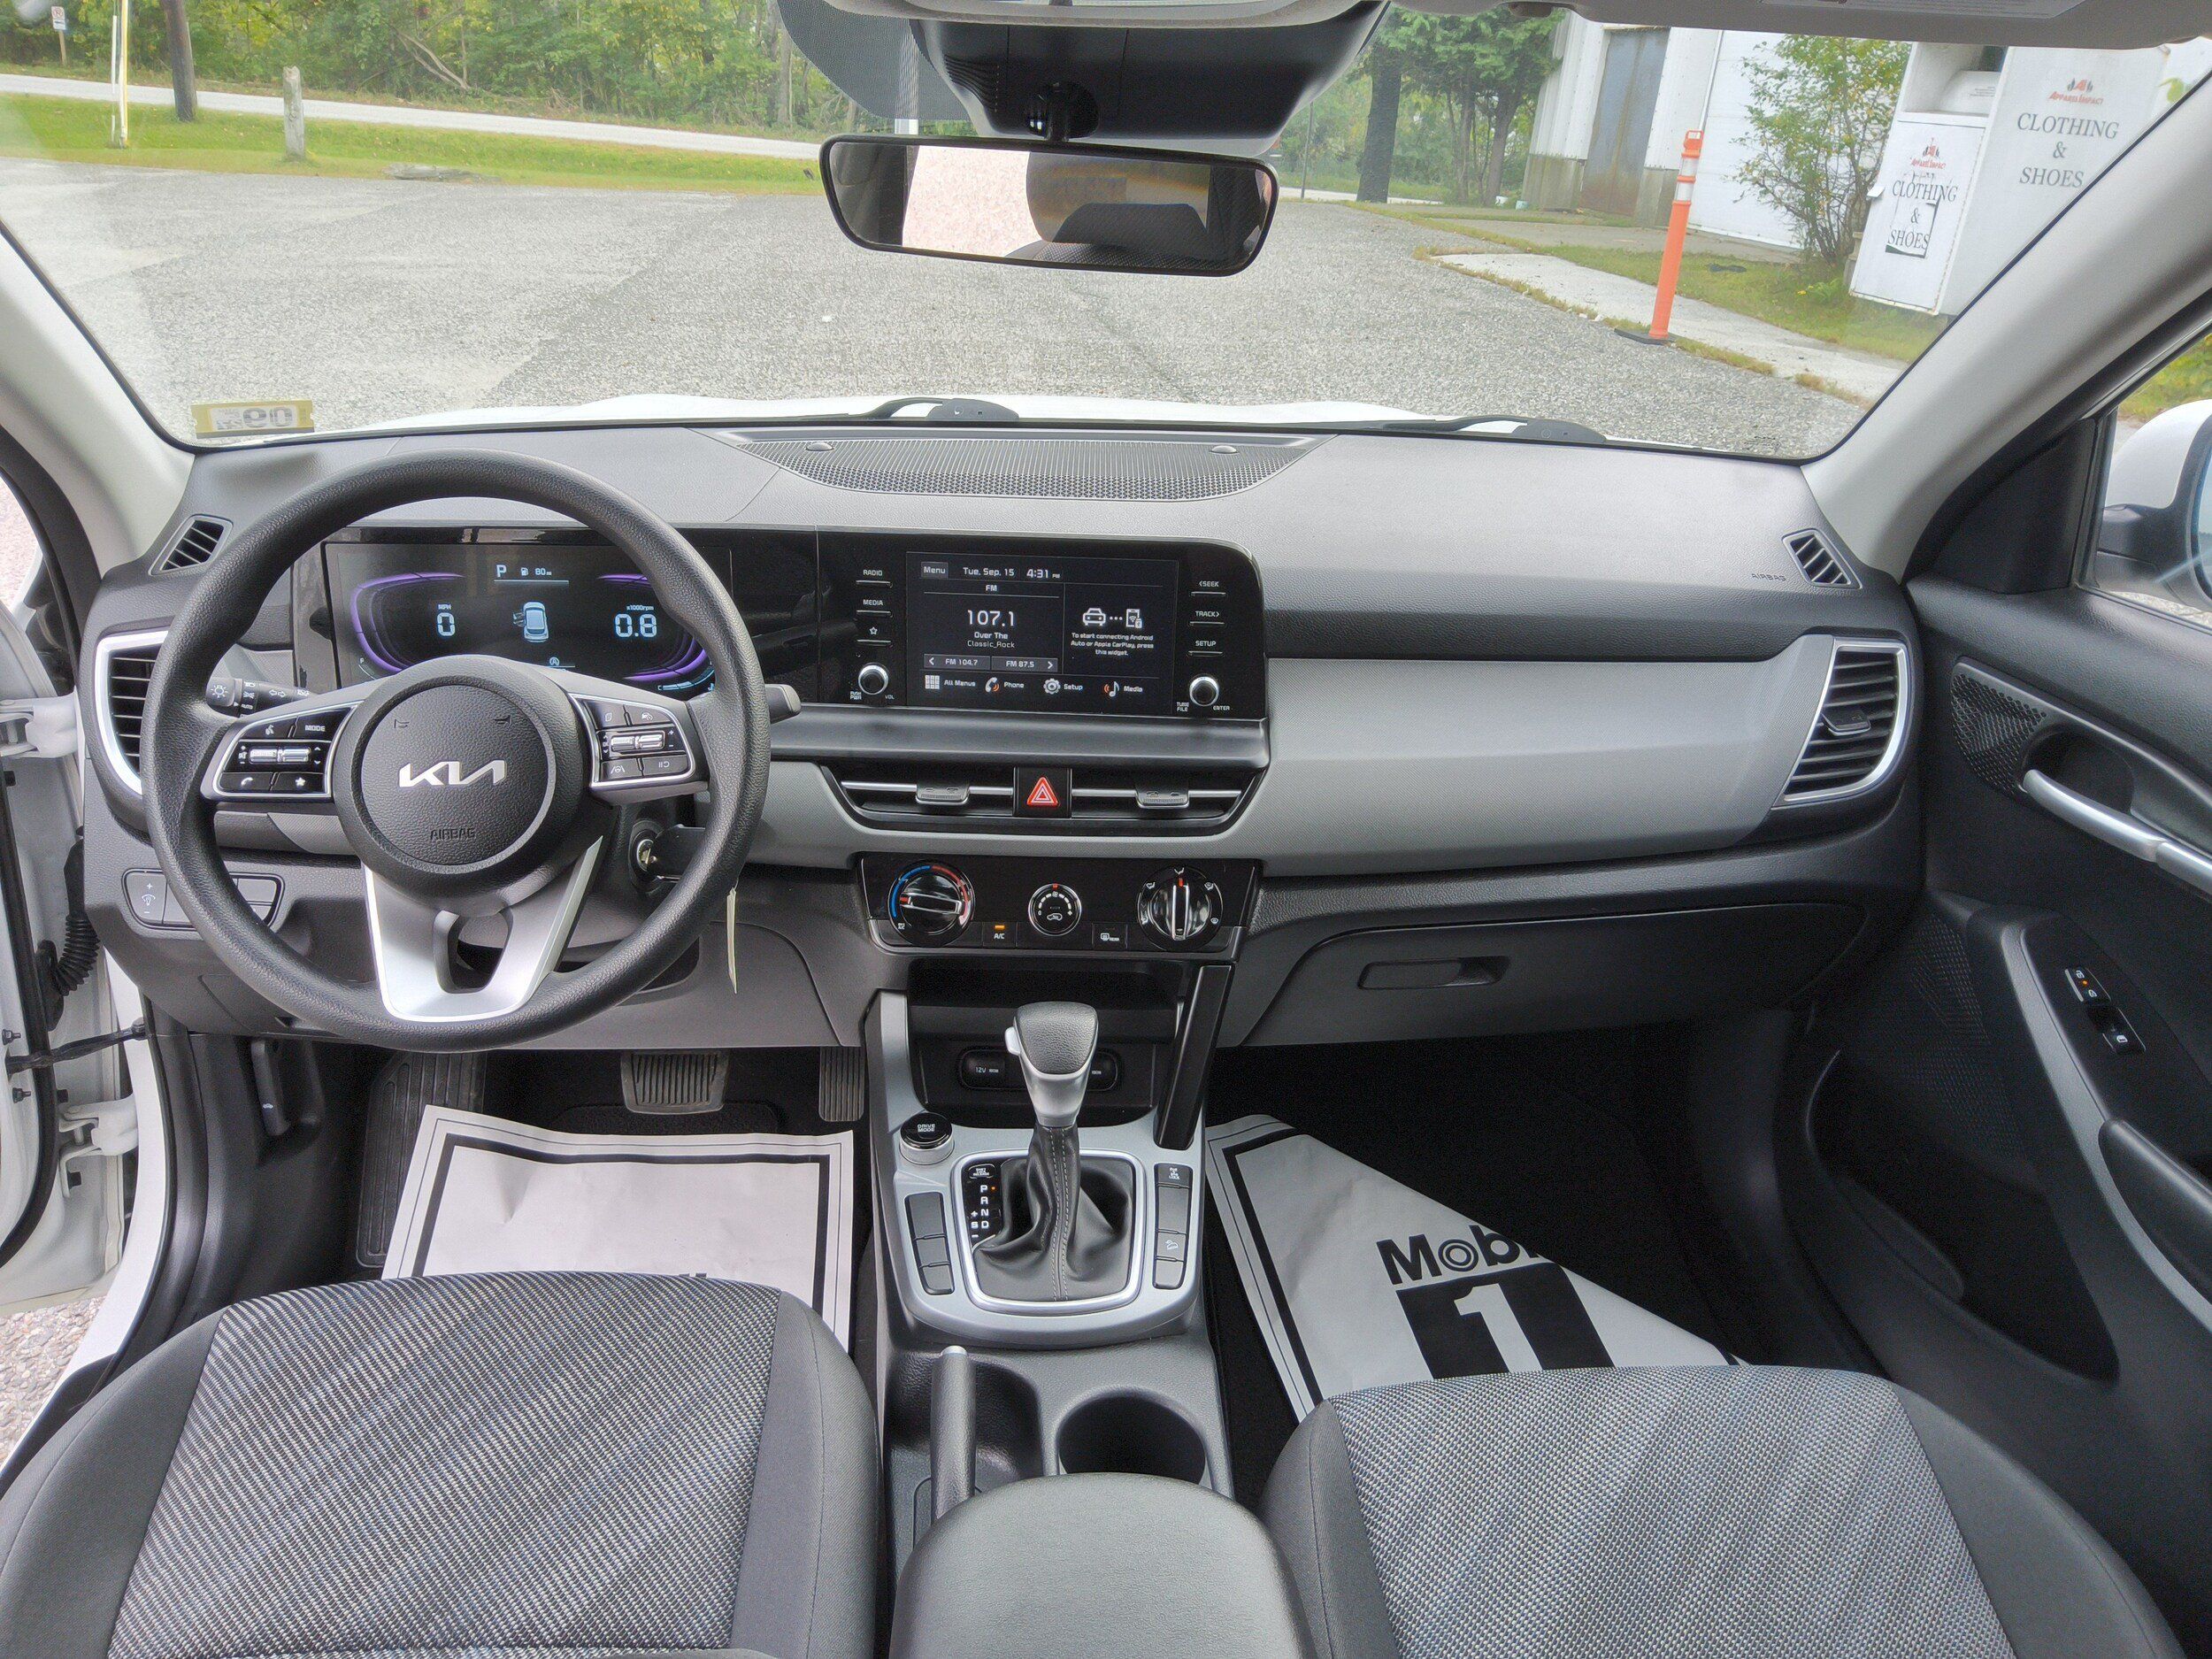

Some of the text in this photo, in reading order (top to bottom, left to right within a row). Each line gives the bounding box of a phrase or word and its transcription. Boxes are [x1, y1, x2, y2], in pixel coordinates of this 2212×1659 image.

[2016, 112, 2120, 139] CLOTHING
[2052, 141, 2068, 158] &
[2019, 166, 2085, 188] SHOES
[1892, 180, 1958, 202] CLOTHING
[1910, 207, 1921, 224] &
[1887, 229, 1930, 250] SHOES
[496, 564, 507, 578] P
[963, 566, 1015, 577] Tue. Sep. 15
[1026, 569, 1048, 579] 4:31
[436, 611, 456, 638] 0
[614, 613, 657, 638] 0.8
[967, 609, 1015, 627] 107.1
[399, 759, 507, 787] KIA
[430, 827, 476, 840] AIRBAG
[981, 1220, 989, 1229] D
[1376, 1225, 1539, 1285] Mob
